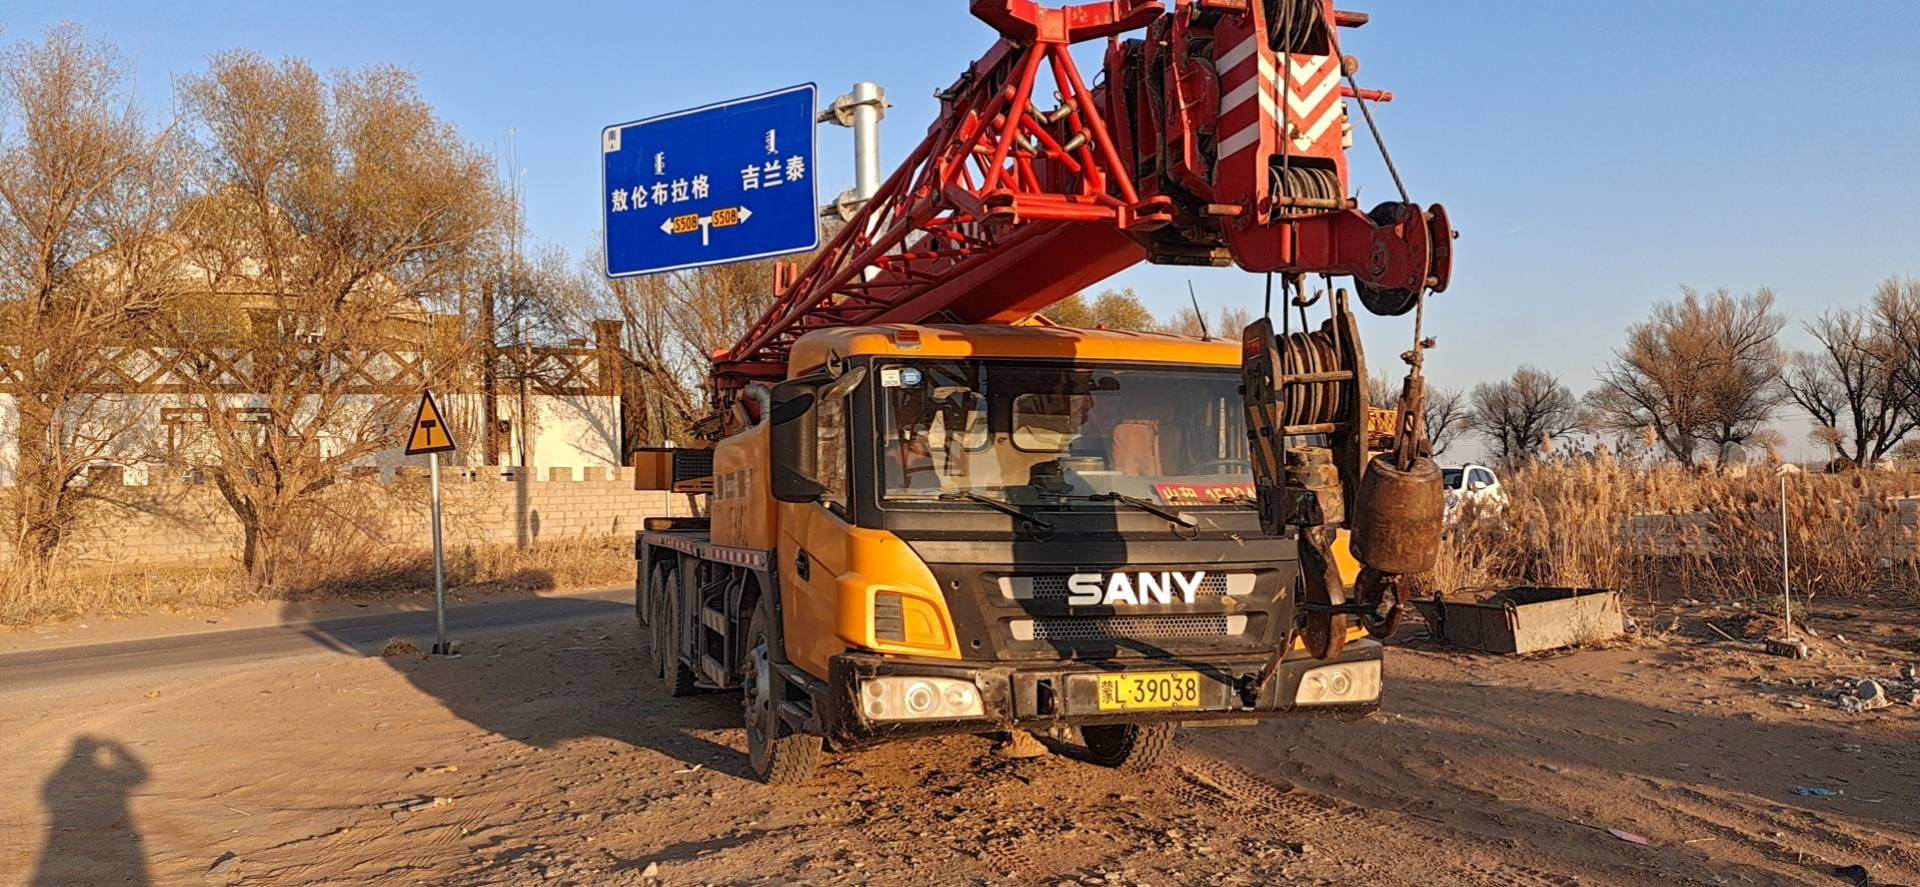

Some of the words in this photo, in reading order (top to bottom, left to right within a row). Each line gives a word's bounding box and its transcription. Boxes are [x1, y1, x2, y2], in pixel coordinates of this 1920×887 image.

[741, 155, 805, 191] 吉兰泰
[611, 174, 710, 212] 敖伦布拉格
[674, 215, 698, 232] S508
[713, 209, 737, 226] S508
[1067, 571, 1206, 605] SANY
